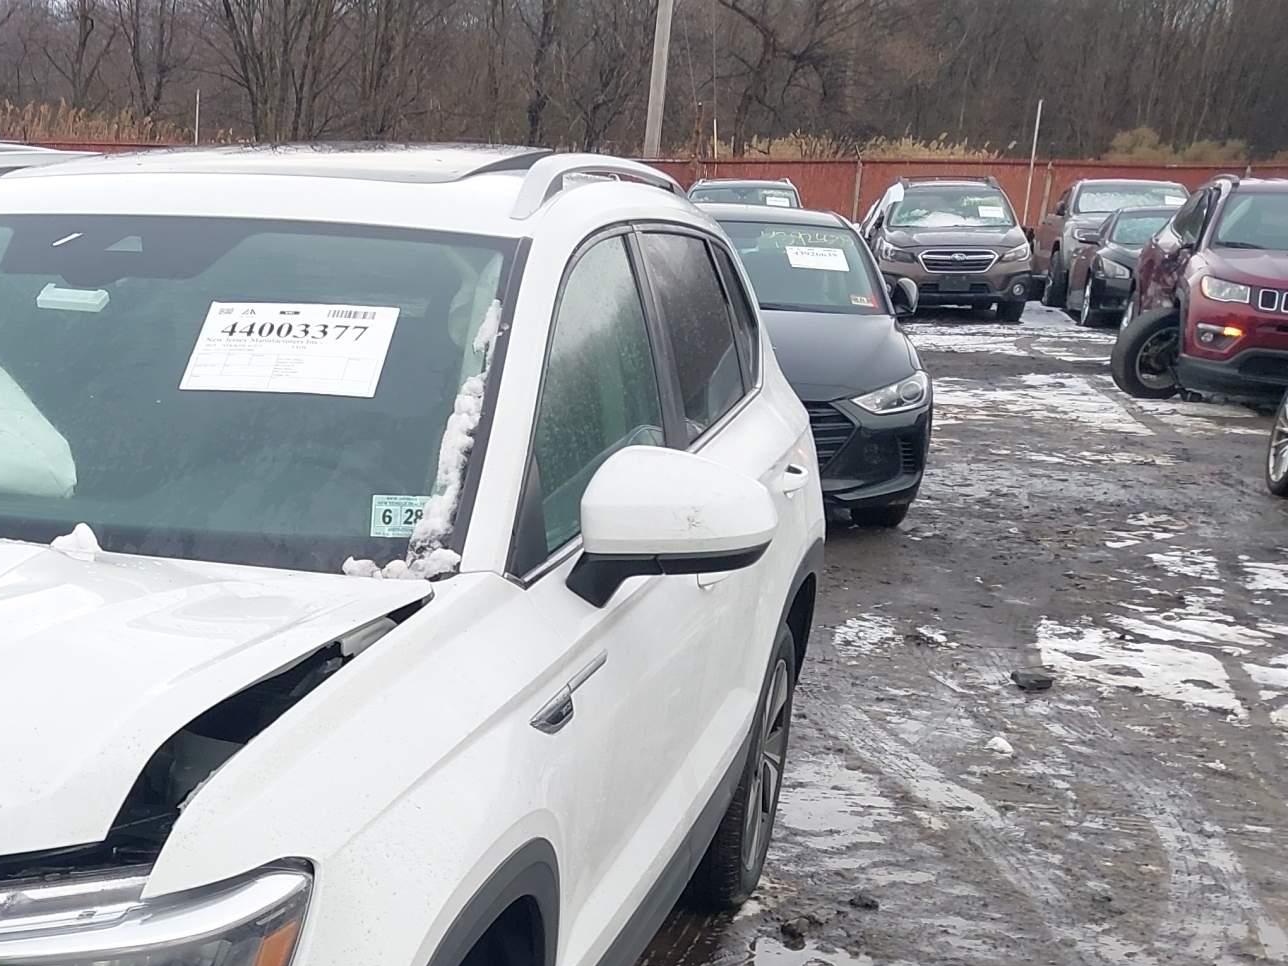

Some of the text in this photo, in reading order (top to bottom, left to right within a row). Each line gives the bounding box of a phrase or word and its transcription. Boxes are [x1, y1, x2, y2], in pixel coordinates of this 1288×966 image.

[220, 320, 370, 342] 44003377
[382, 509, 424, 525] 6 28
